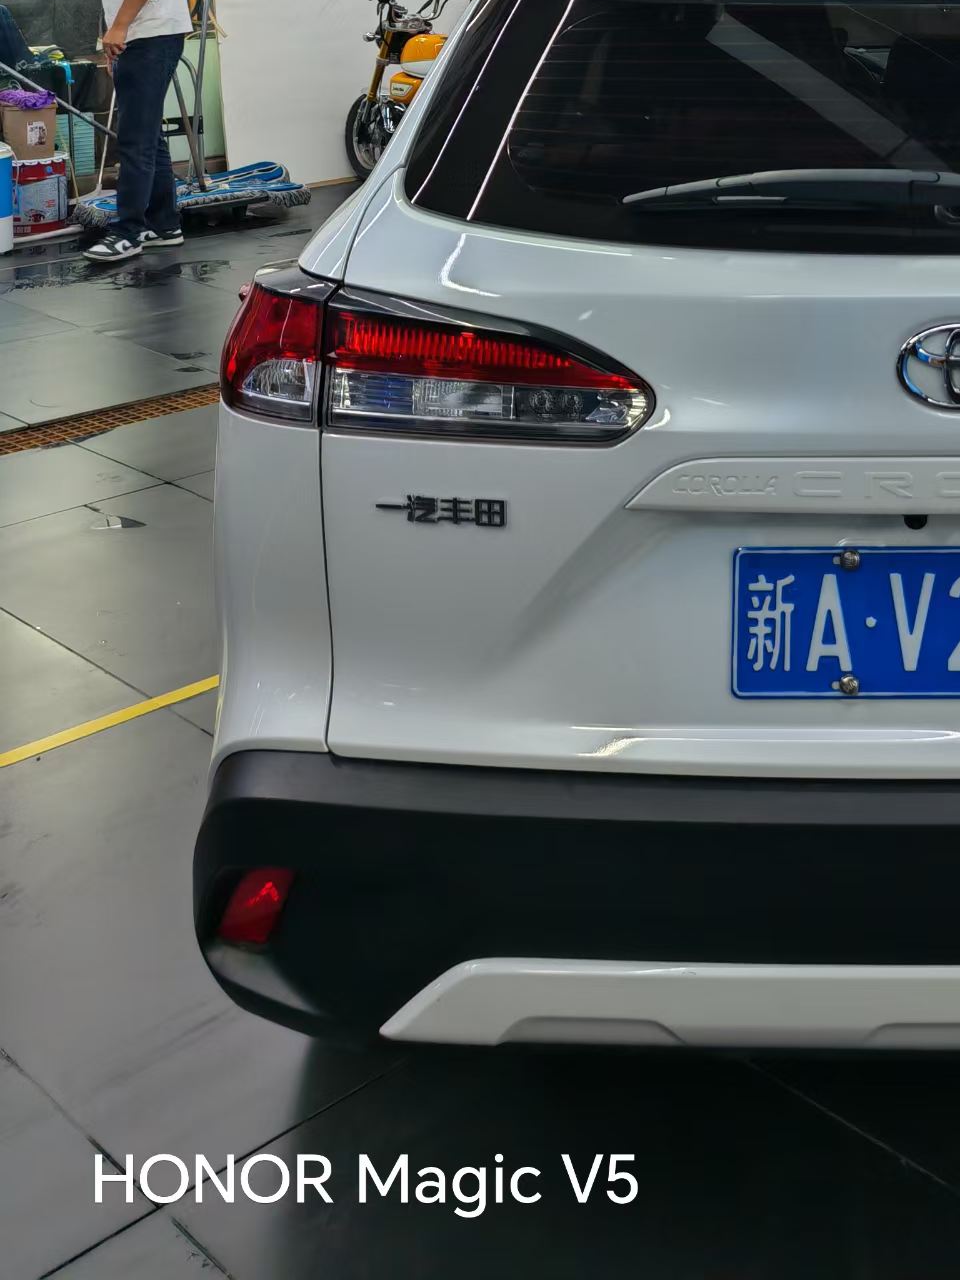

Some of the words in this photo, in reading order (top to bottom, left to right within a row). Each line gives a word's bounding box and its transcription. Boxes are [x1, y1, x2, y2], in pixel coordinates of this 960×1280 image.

[671, 473, 779, 497] COROLLA
[375, 494, 507, 527] 一汽丰田
